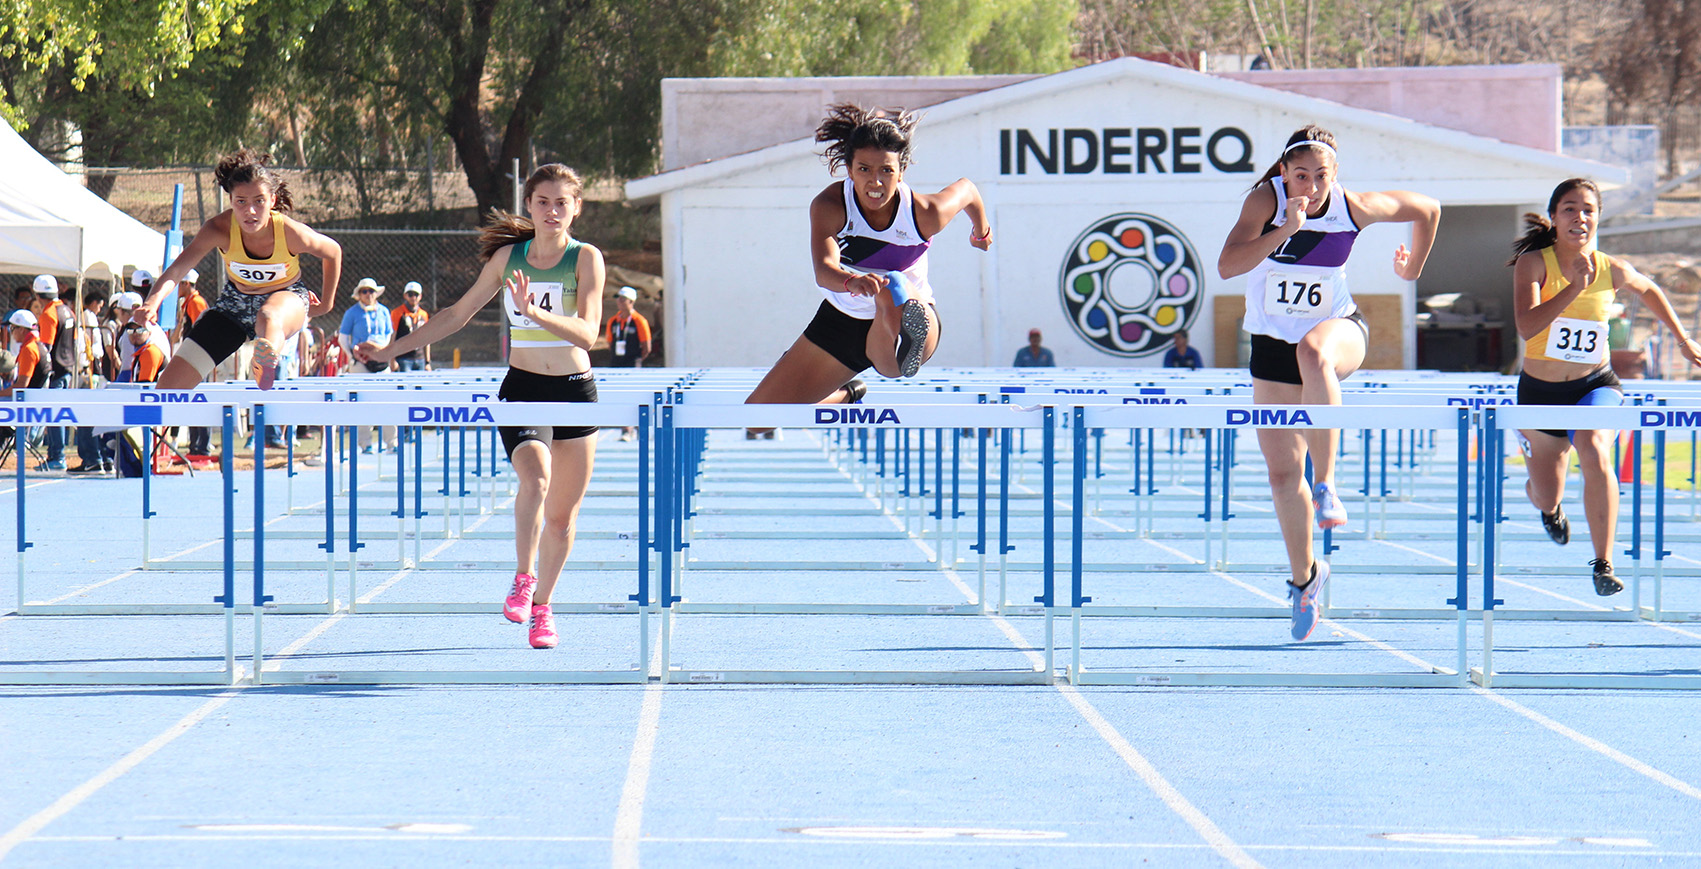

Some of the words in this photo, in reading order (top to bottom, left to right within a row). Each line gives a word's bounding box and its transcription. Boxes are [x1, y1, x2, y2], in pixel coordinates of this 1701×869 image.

[999, 127, 1255, 175] INDEREQ
[239, 269, 276, 280] 307
[1276, 280, 1322, 307] 176
[1556, 327, 1598, 353] 313
[140, 393, 208, 402] DIMA
[0, 407, 78, 423] DIMA
[408, 407, 495, 422] DIMA
[815, 408, 900, 424] DIMA
[1226, 409, 1313, 425] DIMA
